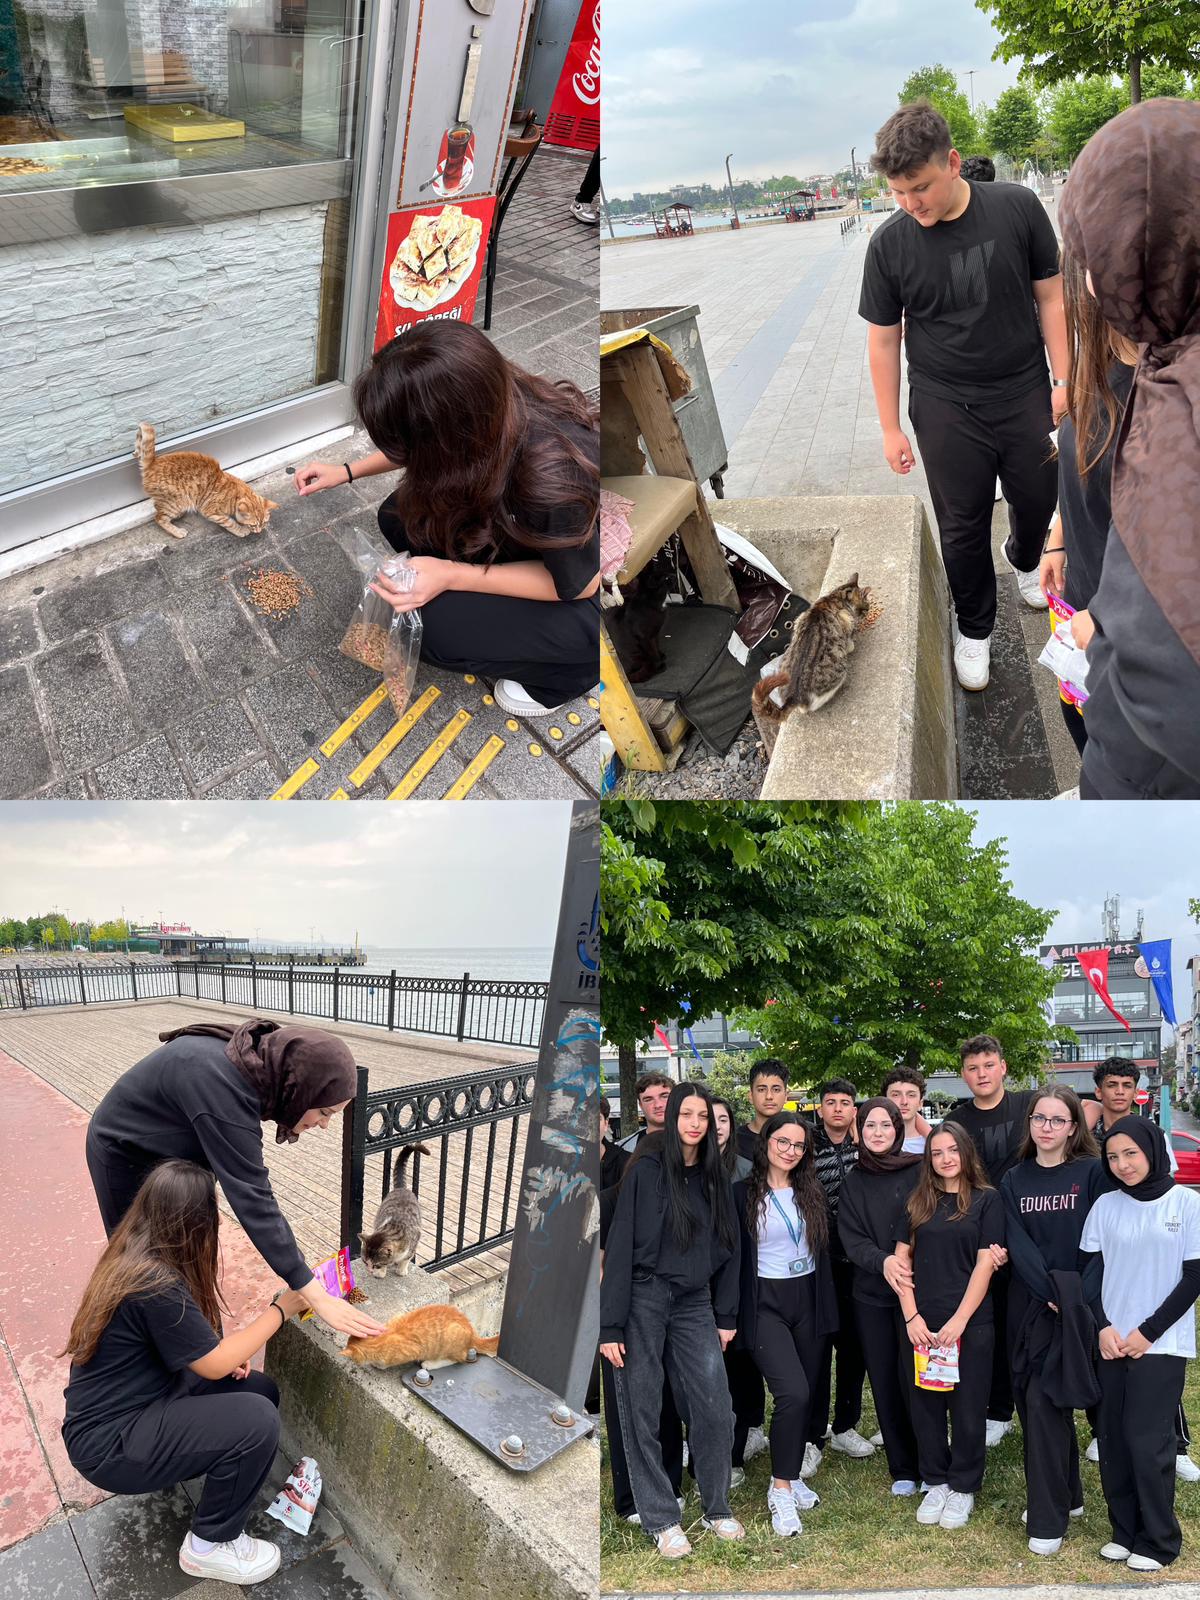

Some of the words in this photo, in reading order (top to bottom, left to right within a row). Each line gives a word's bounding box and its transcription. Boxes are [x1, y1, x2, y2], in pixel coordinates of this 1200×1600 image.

[416, 304, 462, 324] ÖREĞİ
[578, 971, 600, 989] İB
[1020, 1194, 1078, 1214] EDUKENT
